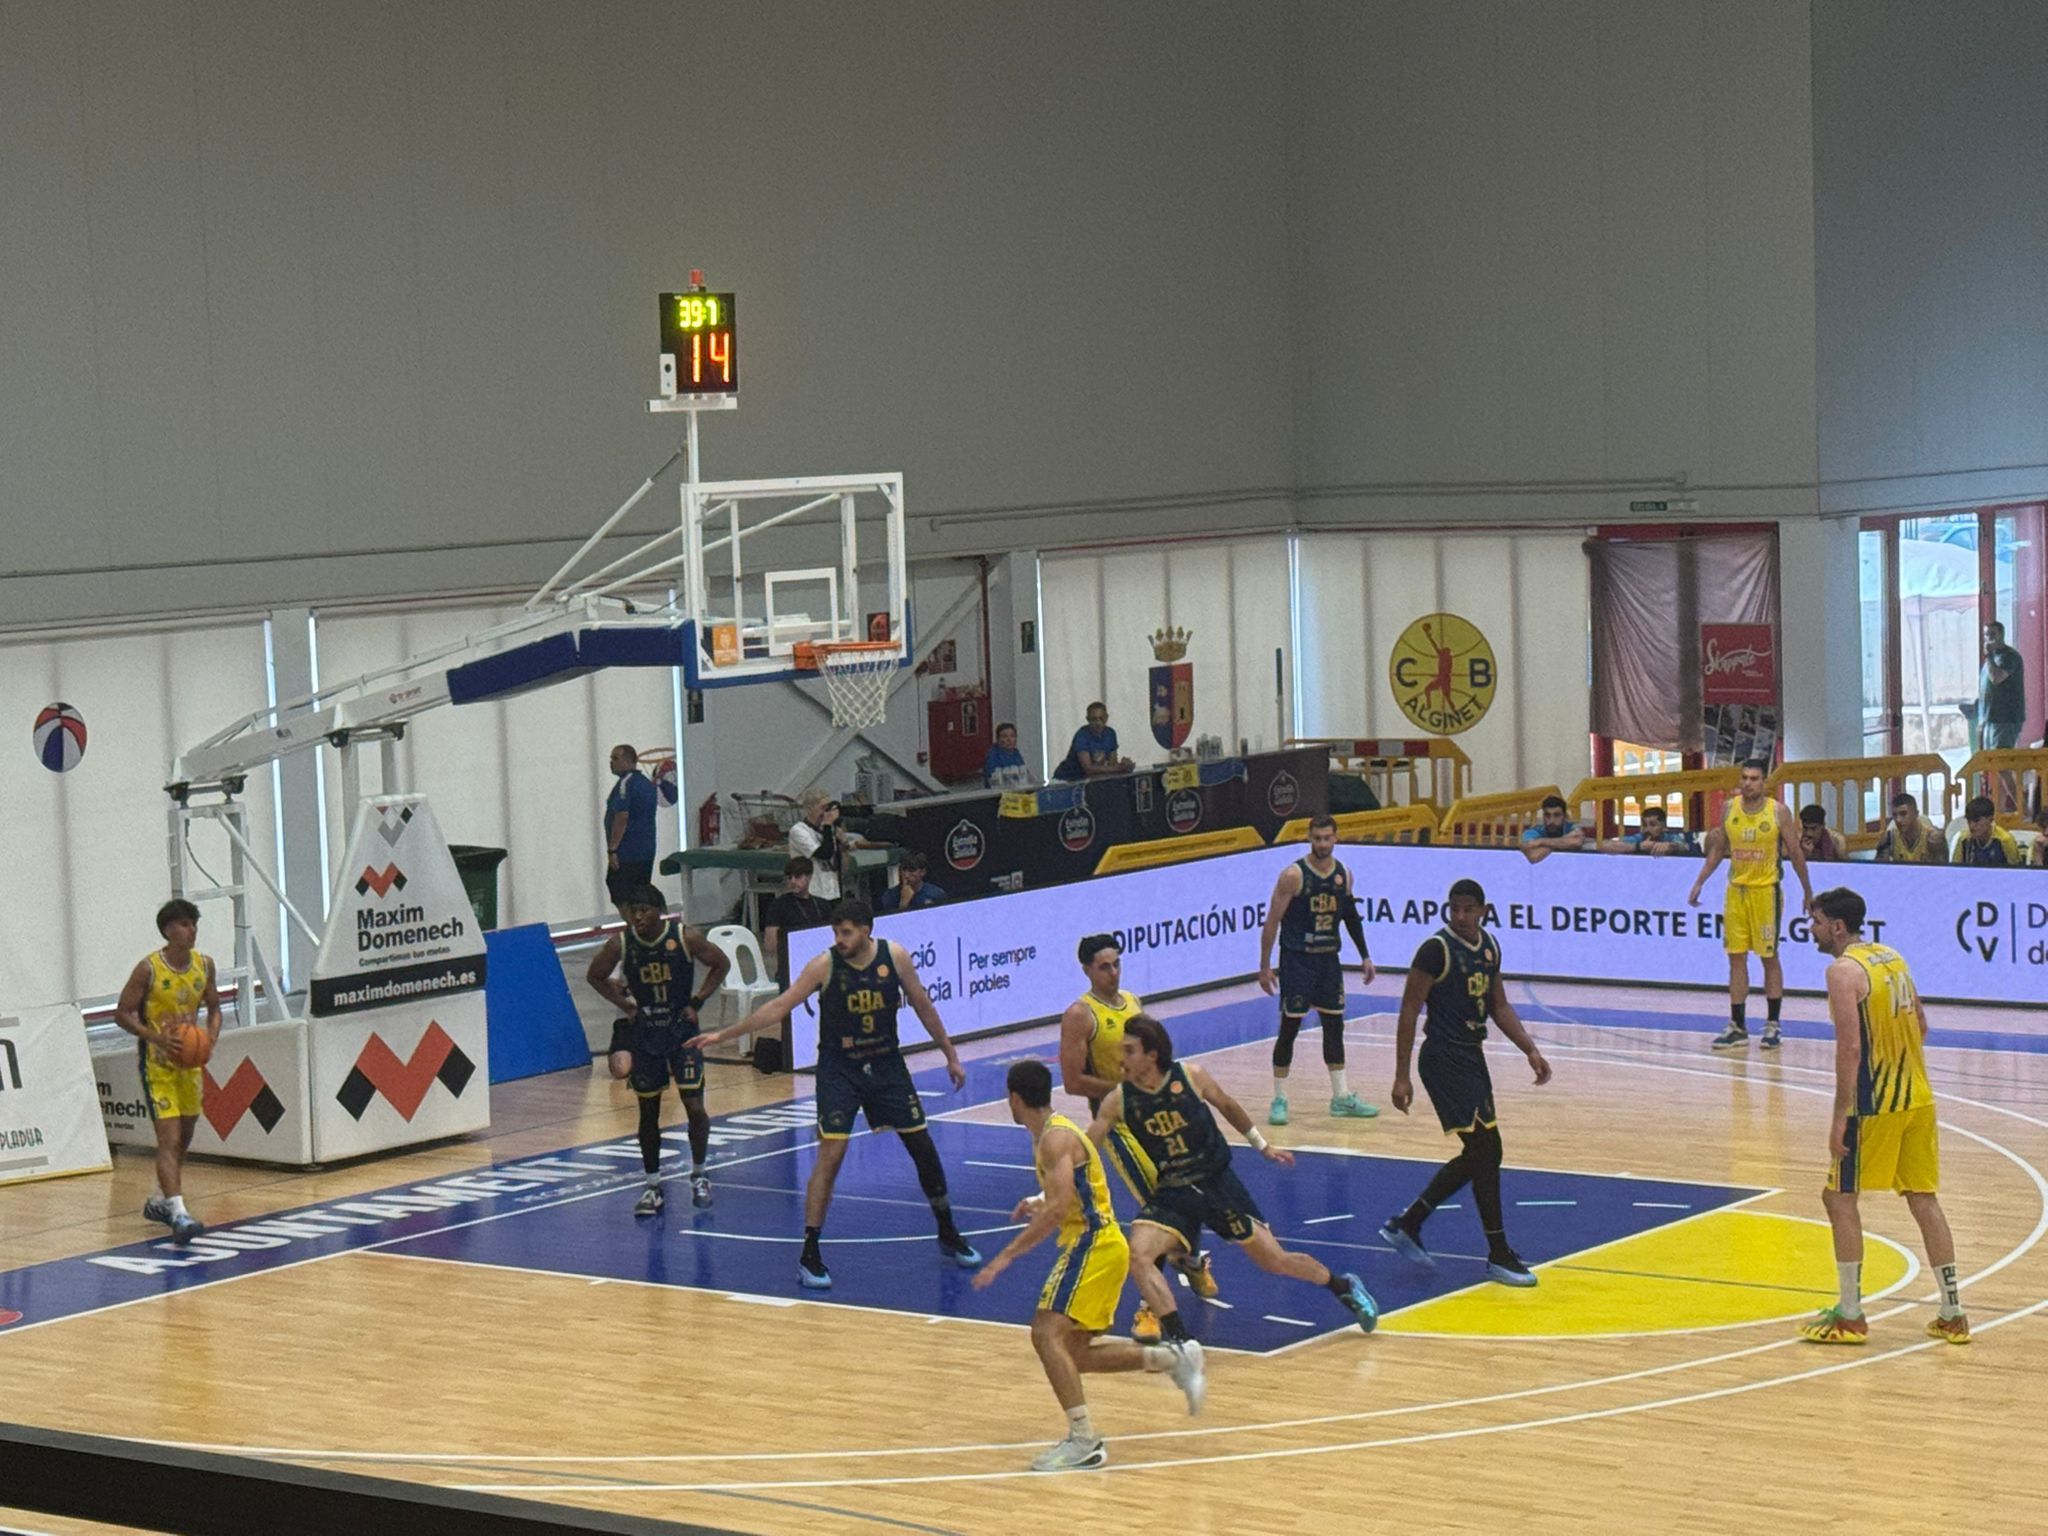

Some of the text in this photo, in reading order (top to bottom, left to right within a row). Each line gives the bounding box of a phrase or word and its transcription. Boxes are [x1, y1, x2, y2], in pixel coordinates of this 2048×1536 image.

[692, 333, 730, 382] 14
[1404, 695, 1487, 729] ALGINET
[1310, 893, 1338, 913] CBA
[357, 904, 424, 929] Maxim
[1112, 903, 1236, 955] DIPUTACIÓN
[1510, 904, 1542, 930] EL
[1551, 906, 1687, 937] DEPORTE
[1315, 914, 1333, 931] 22
[358, 917, 464, 952] Domenech
[968, 945, 1037, 971] Per sempre
[640, 961, 672, 983] CBA
[333, 970, 477, 1007] maximdomenech.es
[969, 973, 1011, 998] pobles
[847, 989, 885, 1013] CBA
[862, 1014, 875, 1034] 9
[1144, 1110, 1188, 1137] CBA
[1164, 1134, 1189, 1157] 21
[86, 1157, 617, 1274] AJUNTAMENT
